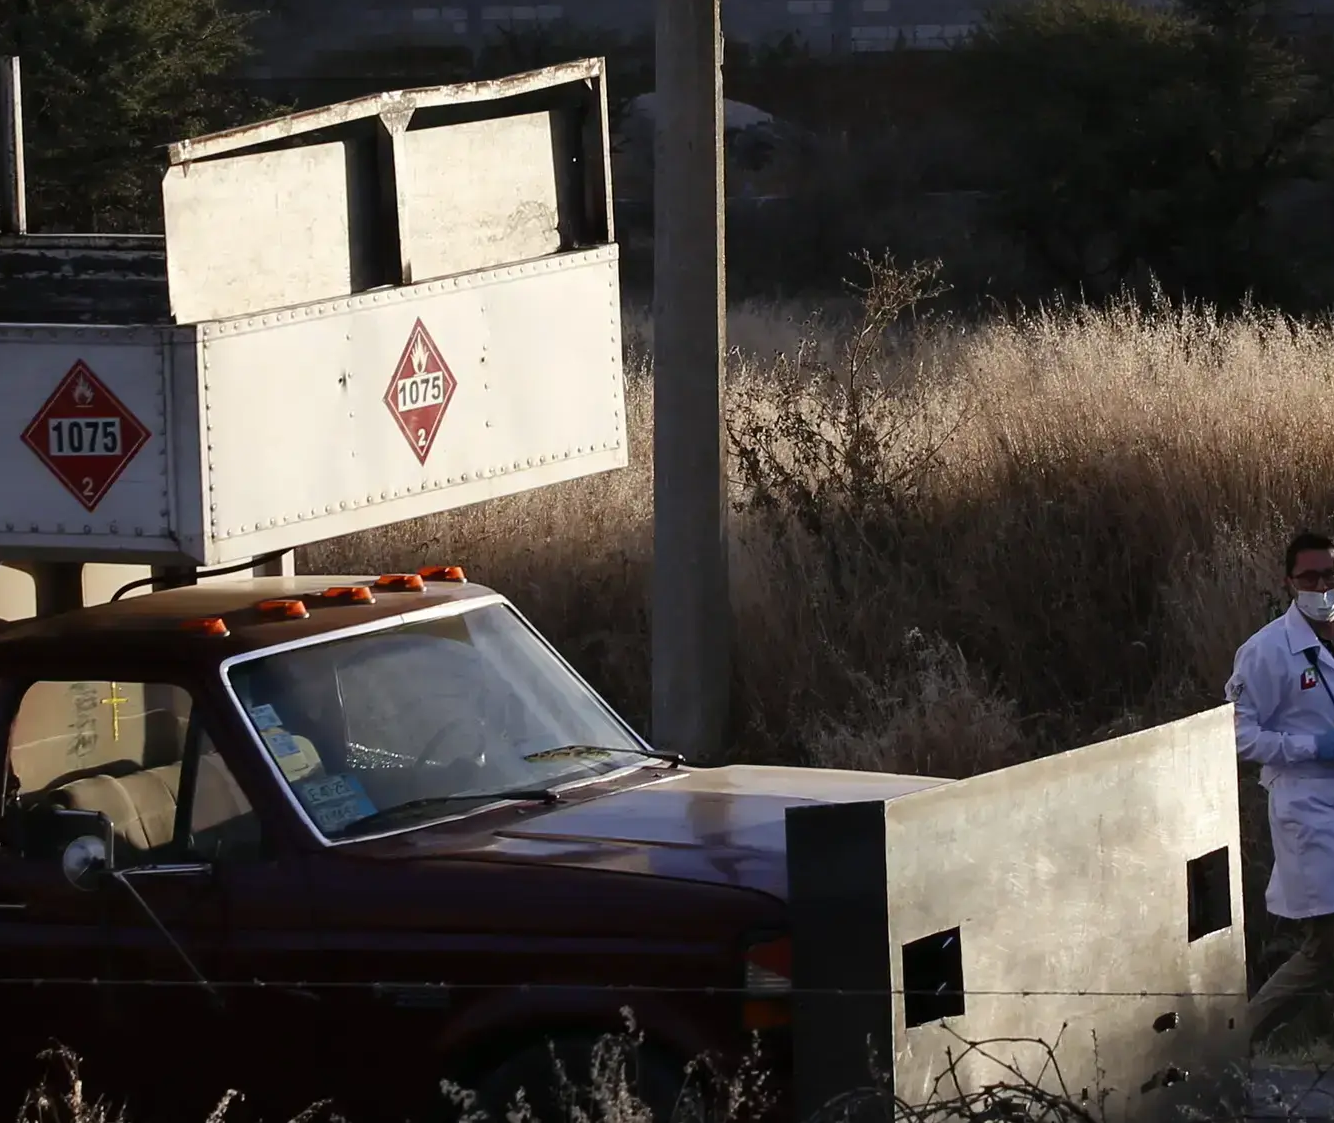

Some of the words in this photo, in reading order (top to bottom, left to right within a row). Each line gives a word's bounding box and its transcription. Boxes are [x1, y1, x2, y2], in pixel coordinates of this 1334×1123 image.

[399, 376, 442, 407] 1075
[51, 421, 118, 453] 1075
[417, 428, 427, 447] 2
[82, 477, 94, 496] 2
